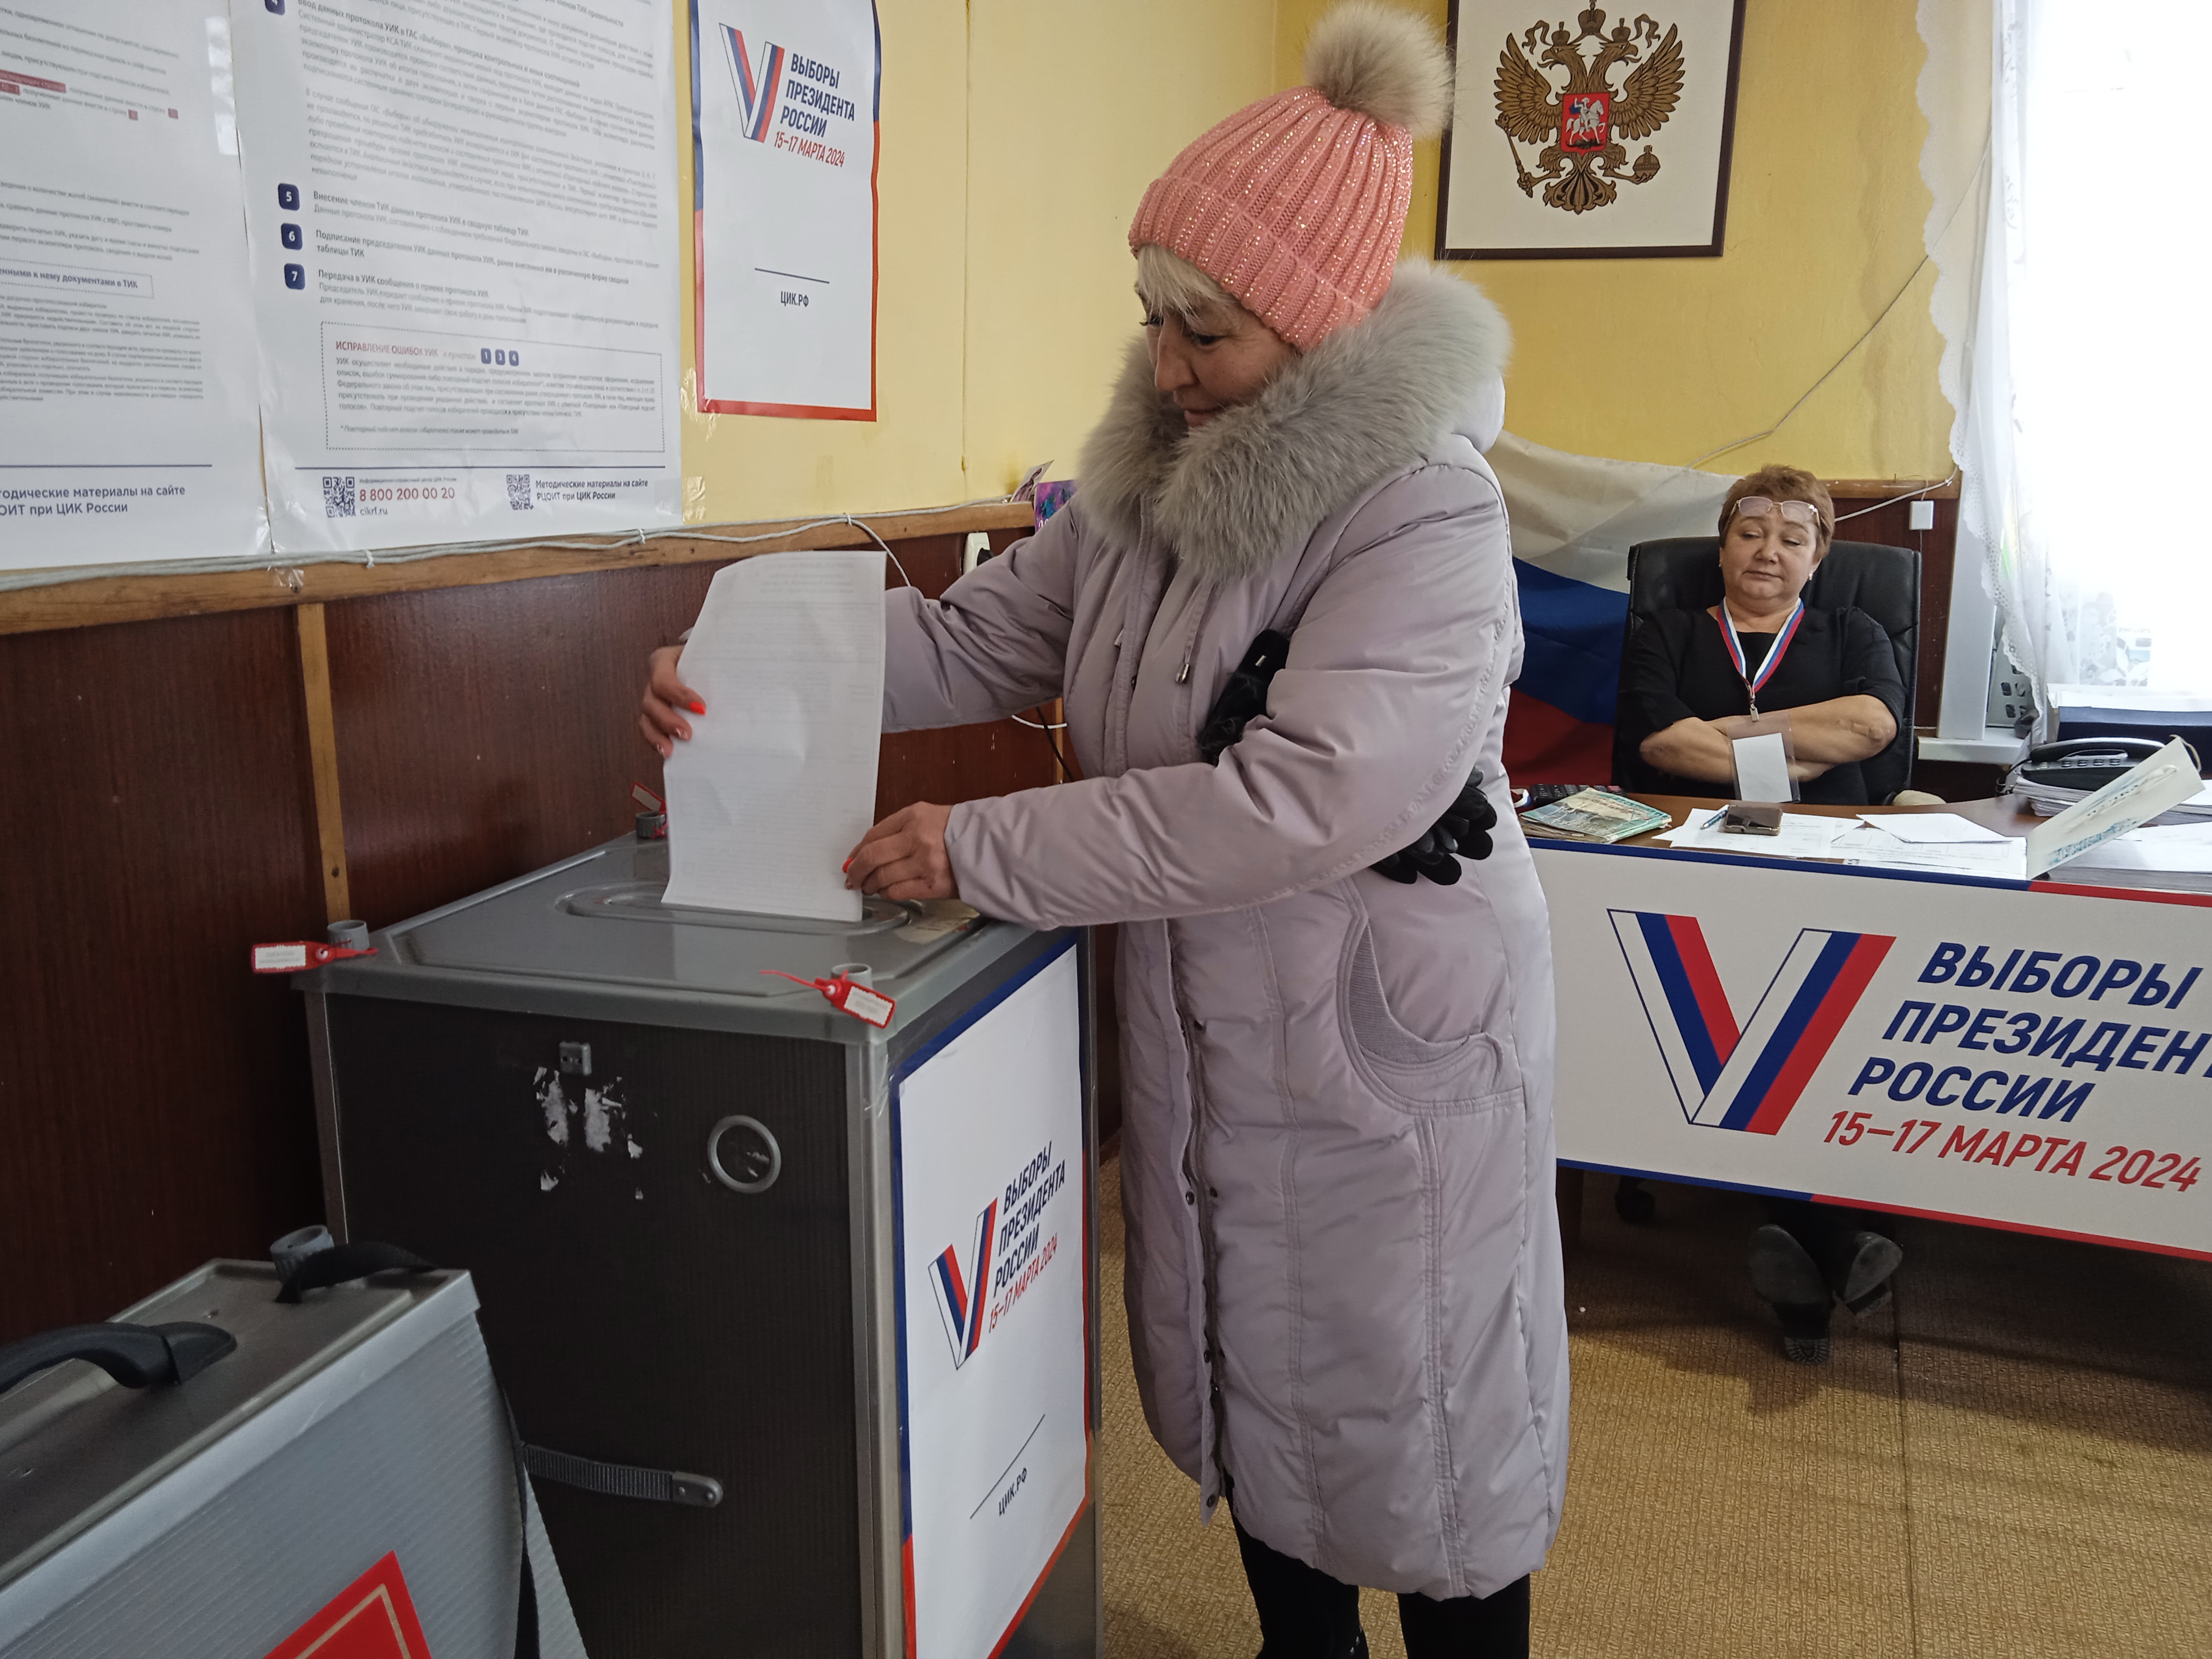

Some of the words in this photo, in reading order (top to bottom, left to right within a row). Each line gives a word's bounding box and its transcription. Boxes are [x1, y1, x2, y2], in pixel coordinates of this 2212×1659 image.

[318, 4, 345, 18] данных
[346, 13, 383, 30] протокола
[384, 22, 399, 34] УИК
[406, 30, 418, 40] ГАС
[791, 53, 840, 89] ВЫБОРЫ
[786, 79, 855, 121] ПРЕЗИДЕНТА
[780, 105, 827, 138] РОССИИ
[797, 138, 826, 162] МАРТА
[825, 147, 845, 167] 2024
[286, 191, 292, 202] 5
[314, 191, 349, 204] Внесение
[349, 199, 375, 209] членом
[376, 202, 389, 212] ТИК
[391, 205, 414, 215] данных
[416, 210, 448, 224] протокола
[449, 215, 462, 224] УИК
[467, 220, 492, 232] сводную
[494, 224, 517, 236] таблицу
[517, 227, 529, 236] ТИК
[289, 231, 295, 241] 6
[316, 229, 361, 245] Подписание
[362, 238, 412, 254] председателем
[413, 244, 426, 254] УИК
[428, 247, 450, 258] данных
[451, 251, 482, 264] протокола
[497, 258, 514, 268] ранее
[591, 272, 608, 282] форму
[317, 244, 349, 257] таблицы
[350, 247, 365, 258] ТИК
[40, 273, 60, 282] нему
[62, 275, 115, 286] документами
[123, 280, 138, 288] ТИК
[292, 271, 298, 282] 7
[319, 269, 354, 282] Передача
[361, 274, 375, 284] УИК
[377, 278, 414, 290] сообщения
[421, 283, 444, 293] приеме
[445, 286, 476, 297] протокола
[477, 289, 489, 298] УИК
[319, 282, 365, 296] Председатель
[320, 295, 333, 305] для
[781, 290, 809, 307] ЦИК.РФ
[336, 341, 390, 355] ИСПРАВЛЕНИЕ
[392, 346, 423, 357] ОШИБОК
[424, 348, 439, 358] УИК
[484, 351, 488, 360] 1
[499, 352, 502, 362] 3
[337, 357, 349, 366] УИК
[73, 485, 137, 499] материалы
[141, 487, 153, 496] на
[156, 485, 186, 495] сайте
[360, 489, 366, 501] 8
[370, 488, 392, 501] 800
[397, 488, 418, 500] 200
[423, 487, 438, 499] 00
[441, 487, 455, 499] 20
[536, 480, 585, 489] Методические
[587, 480, 622, 489] материалы
[632, 478, 648, 487] сайте
[537, 492, 560, 501] РЦОИТ
[576, 491, 591, 501] ЦИК
[592, 491, 616, 499] России
[30, 506, 53, 516] при
[56, 503, 83, 516] ЦИК
[87, 502, 128, 513] России
[360, 506, 388, 515] cikrf.ru
[1917, 942, 2204, 1010] ВЫБОРЫ
[1882, 1000, 2212, 1078] ПРЕЗИДЕН
[1848, 1057, 2096, 1123] РОССИИ
[1938, 1125, 2087, 1176] МАРТА
[2088, 1145, 2202, 1192] 2024
[1003, 1140, 1052, 1216] ВЫБОРЫ
[998, 1159, 1065, 1257] ПРЕЗИДЕНТА
[993, 1222, 1040, 1298] РОССИИ
[1012, 1255, 1040, 1305] МАРТА
[1040, 1232, 1058, 1272] 2024
[999, 1468, 1027, 1516] ЦИК.РФ
